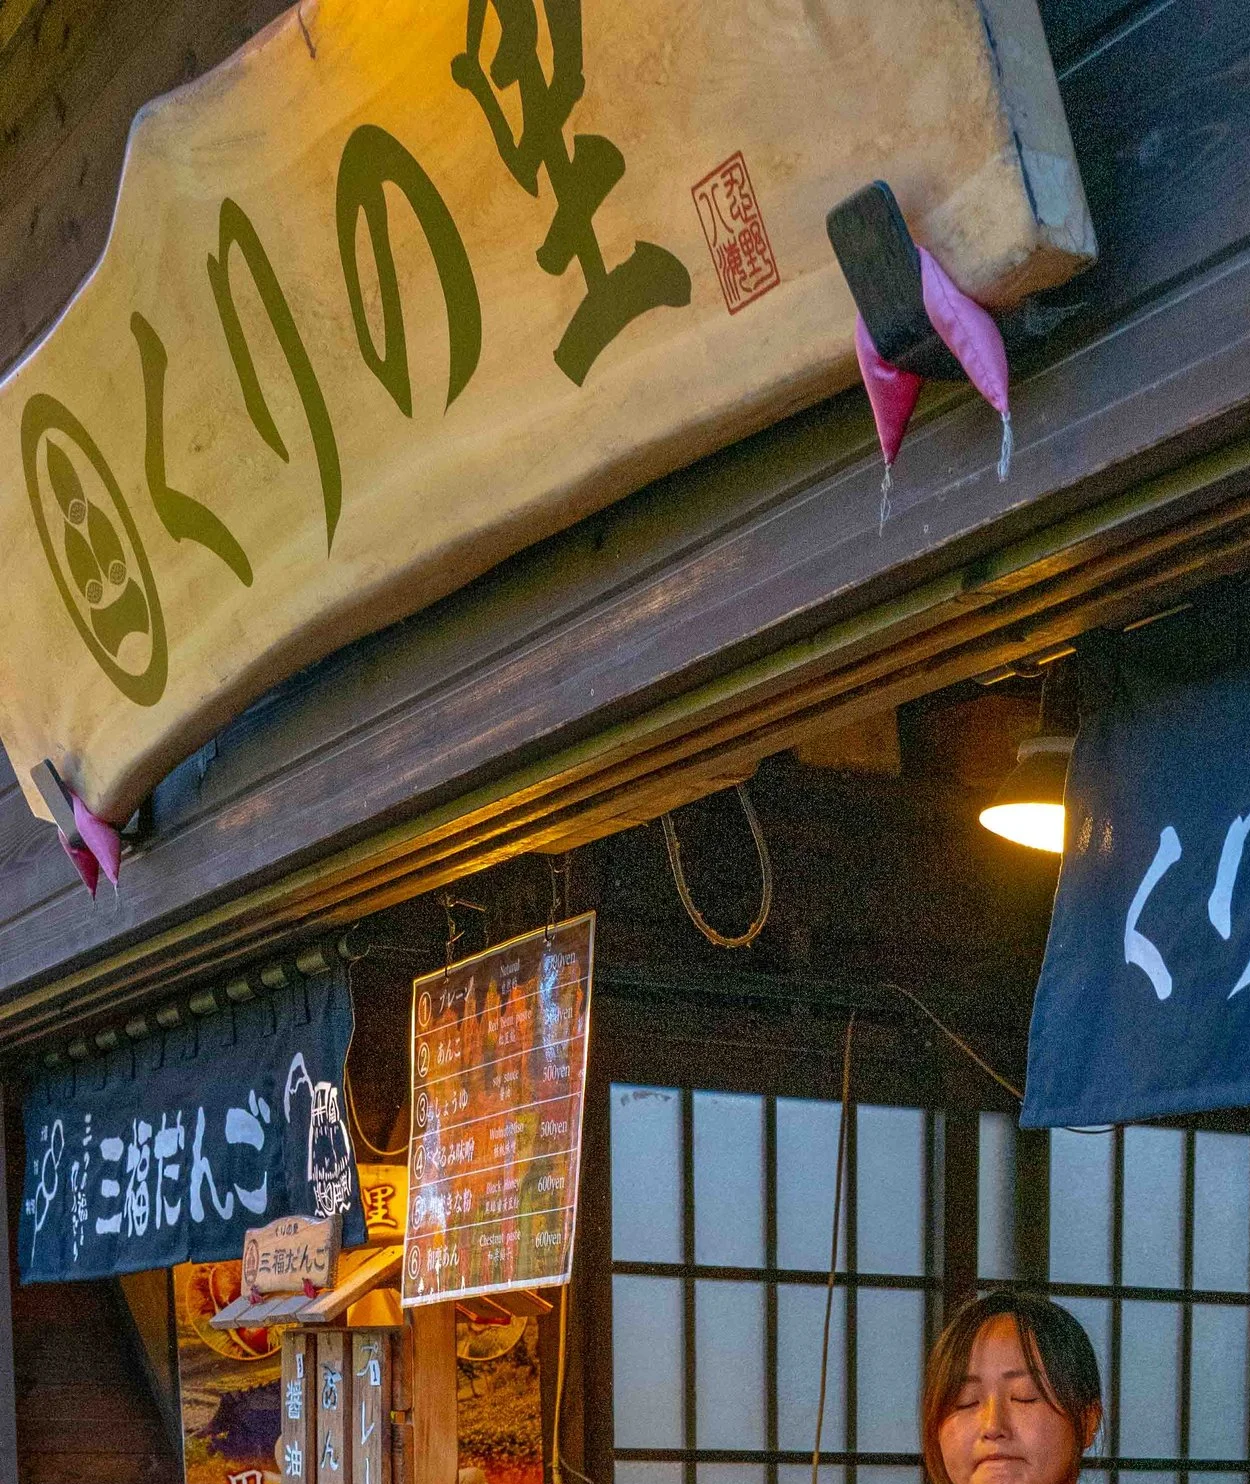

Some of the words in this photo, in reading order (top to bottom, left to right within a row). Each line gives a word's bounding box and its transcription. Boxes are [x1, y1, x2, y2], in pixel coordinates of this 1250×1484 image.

[436, 1038, 462, 1065] あんこ
[96, 1089, 271, 1238] 三福だんご
[259, 1243, 327, 1276] 三福だんご
